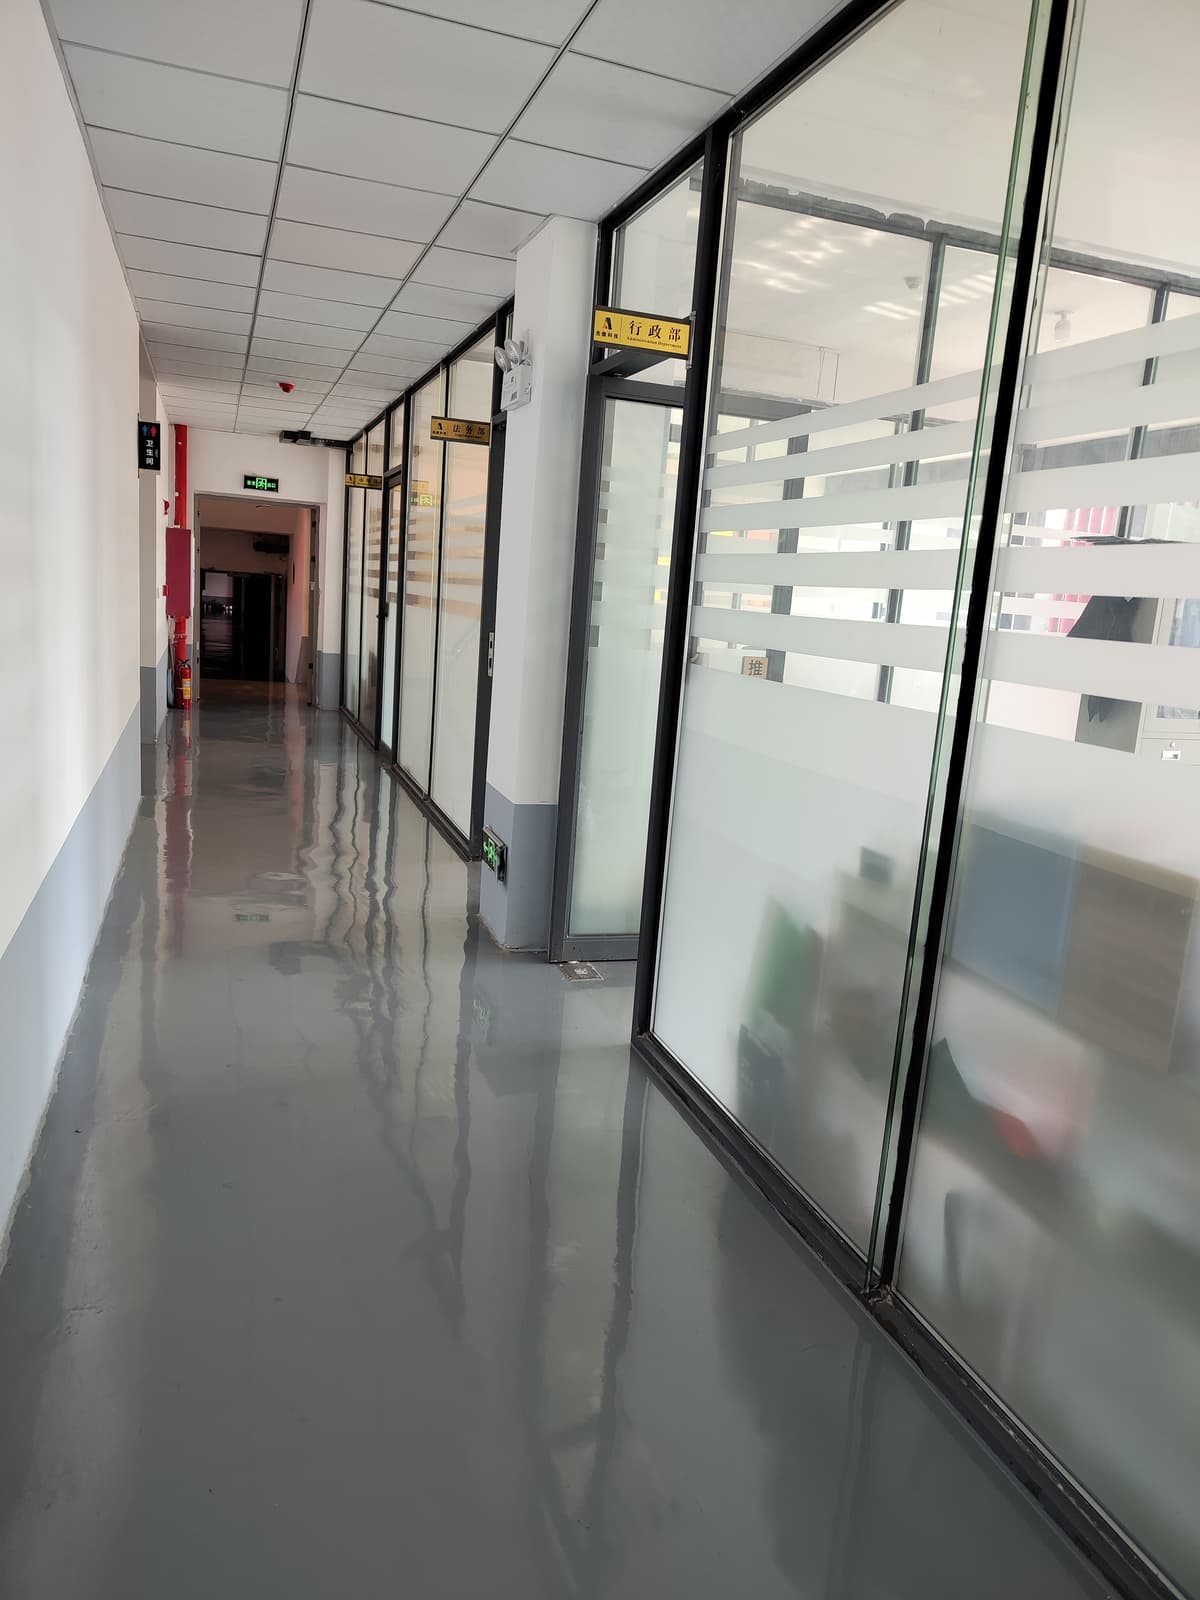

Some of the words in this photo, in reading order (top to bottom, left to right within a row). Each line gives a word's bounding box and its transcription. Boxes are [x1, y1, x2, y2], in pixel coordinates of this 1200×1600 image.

[629, 320, 681, 342] 行政部
[145, 439, 154, 465] 卫生间
[748, 659, 763, 676] 推
